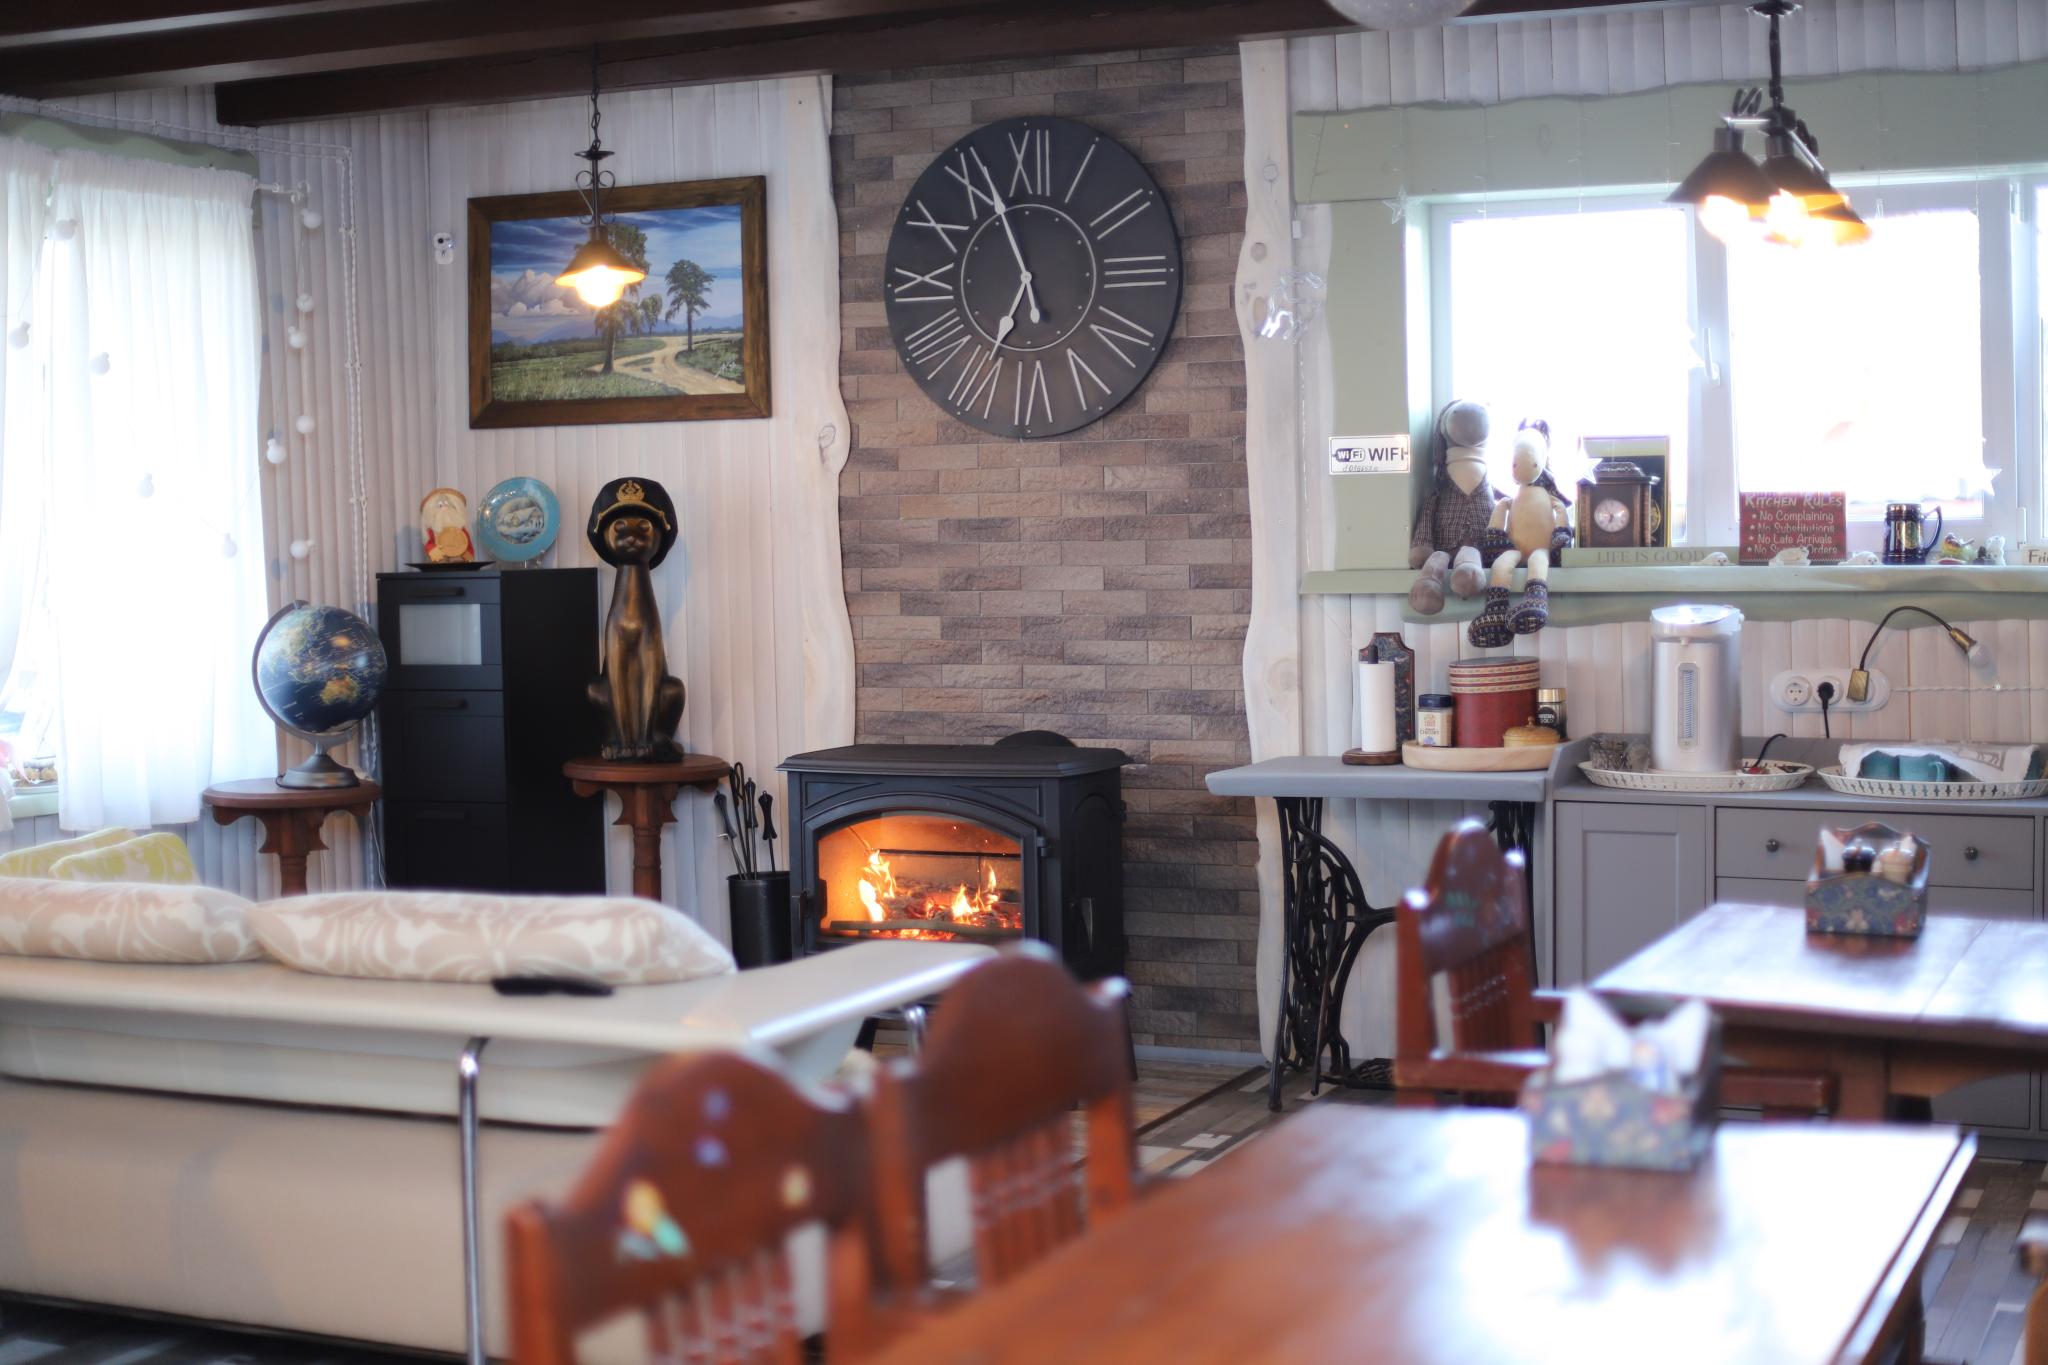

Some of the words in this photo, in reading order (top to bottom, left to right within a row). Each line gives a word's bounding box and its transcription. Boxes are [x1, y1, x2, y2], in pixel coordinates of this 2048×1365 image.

[1008, 129, 1051, 198] XII
[1368, 448, 1404, 461] WIFI
[1760, 510, 1773, 521] No
[1776, 510, 1834, 524] Complaining
[1758, 534, 1771, 544] No
